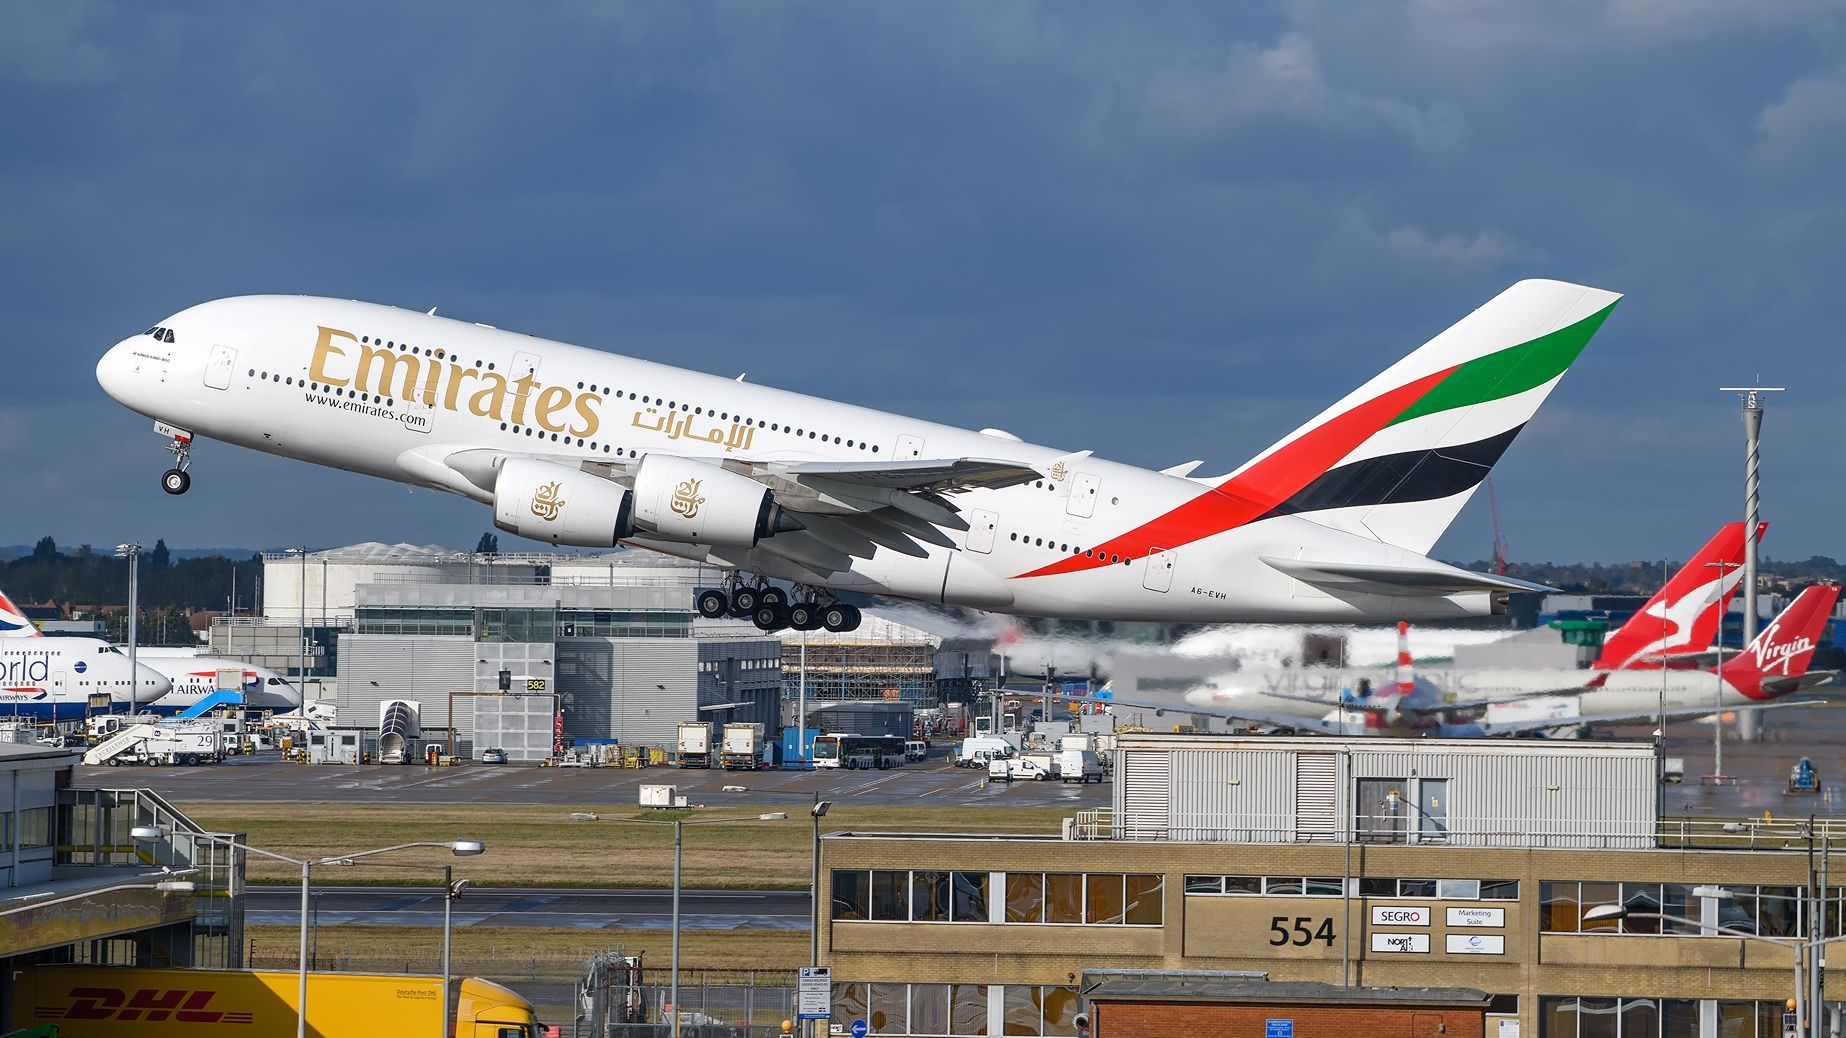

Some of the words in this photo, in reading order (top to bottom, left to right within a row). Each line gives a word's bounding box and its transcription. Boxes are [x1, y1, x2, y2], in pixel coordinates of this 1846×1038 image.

[309, 325, 603, 439] Emirates
[305, 392, 426, 428] www.emirates.com
[158, 425, 170, 435] VH
[1190, 586, 1227, 600] A6-EVH
[1751, 624, 1815, 675] Virgin
[528, 681, 545, 690] 582
[197, 735, 213, 747] 29
[1381, 911, 1420, 922] SEGRO
[1458, 910, 1492, 918] Marketing
[1270, 916, 1337, 947] 554
[64, 988, 225, 1023] DHL
